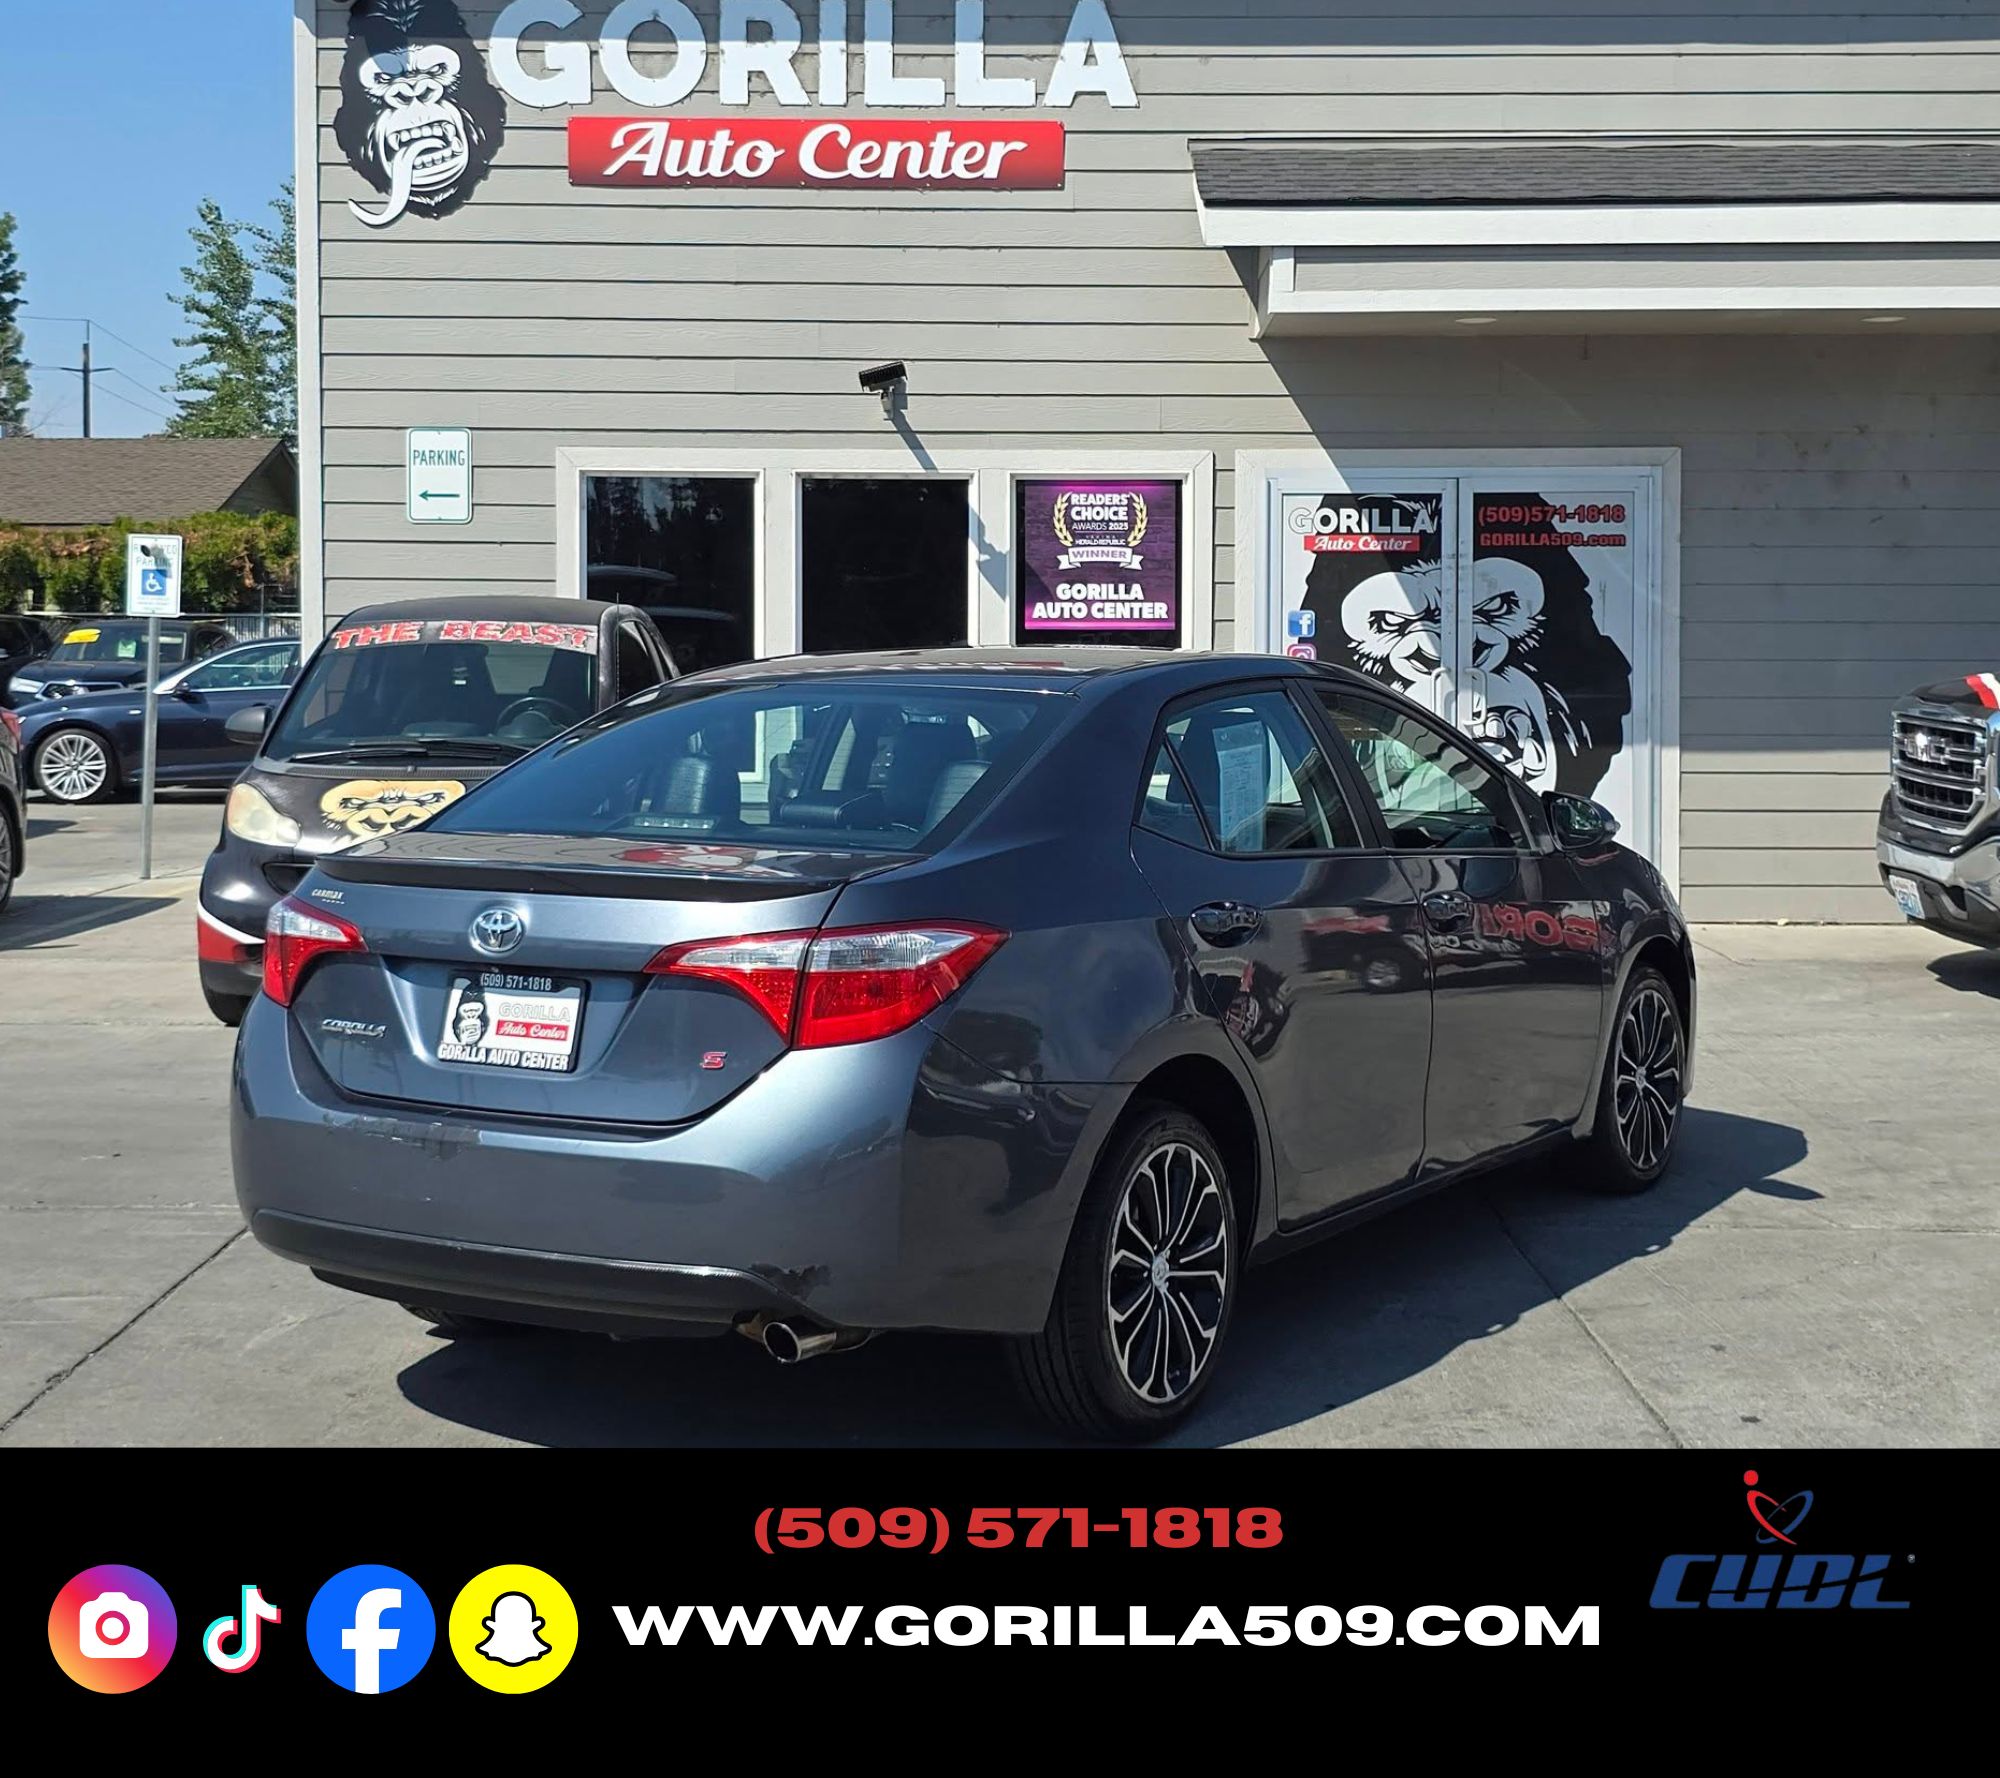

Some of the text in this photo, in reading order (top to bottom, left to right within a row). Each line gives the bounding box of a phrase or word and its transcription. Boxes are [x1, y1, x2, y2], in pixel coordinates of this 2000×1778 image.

[490, 0, 1140, 108] GORILLA
[602, 121, 1028, 181] Auto Center
[413, 449, 465, 466] PARKING
[1071, 506, 1128, 521] CHOICE
[1288, 507, 1434, 534] GORILLA
[1478, 505, 1625, 526] (509)571-1818
[1072, 522, 1107, 530] AWARDS
[1314, 535, 1413, 551] Auto Center
[1479, 533, 1626, 547] GORILLA509.com
[1071, 550, 1127, 559] WINNER
[1056, 583, 1144, 600] GORILLA
[1032, 602, 1168, 619] AUTO CENTER
[332, 620, 598, 649] THE BEAST
[480, 973, 552, 991] (509) 571-1818
[499, 1002, 571, 1022] GORILLA
[499, 1021, 566, 1039] Auto Center
[437, 1043, 569, 1071] GORILLA AUTO CENTER
[702, 1051, 727, 1070] S
